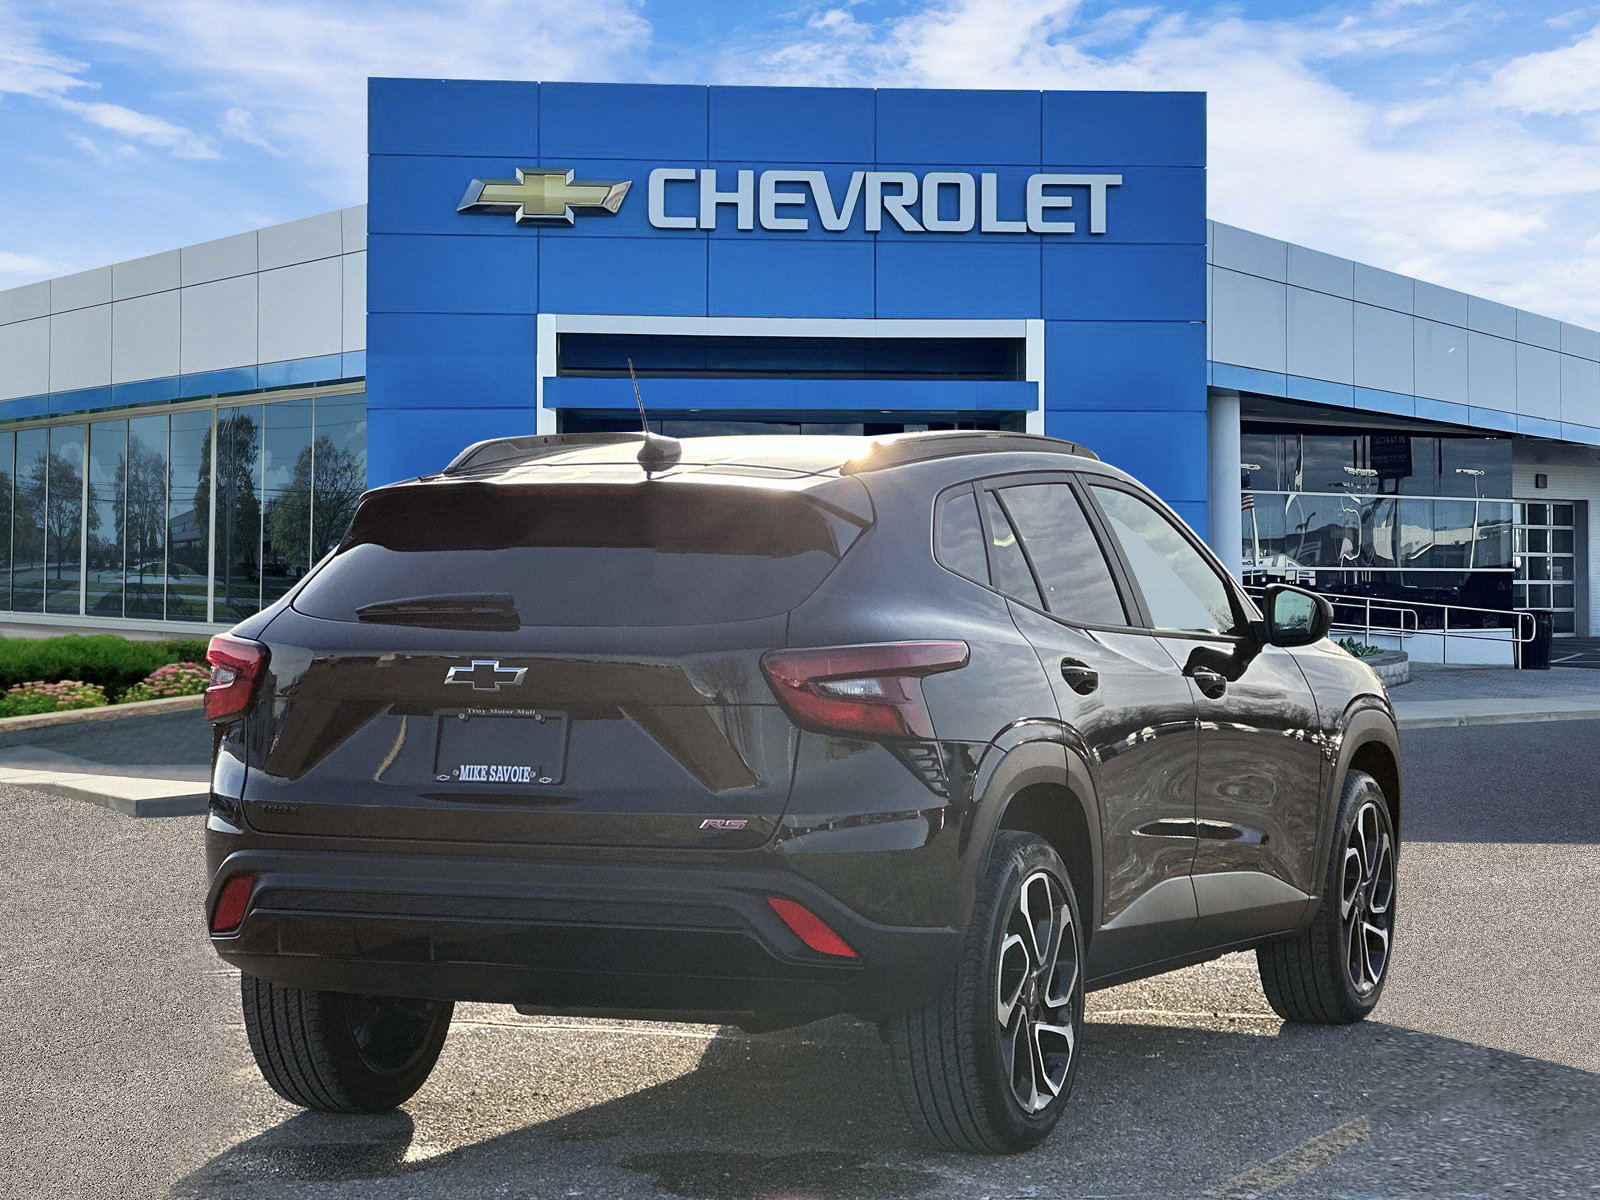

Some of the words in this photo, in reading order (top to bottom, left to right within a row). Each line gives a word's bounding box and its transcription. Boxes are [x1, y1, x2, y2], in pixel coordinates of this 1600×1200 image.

[648, 168, 1123, 233] CHEVROLET
[459, 765, 488, 781] MIKE
[489, 765, 531, 782] SAVOIE
[699, 819, 748, 829] RS
